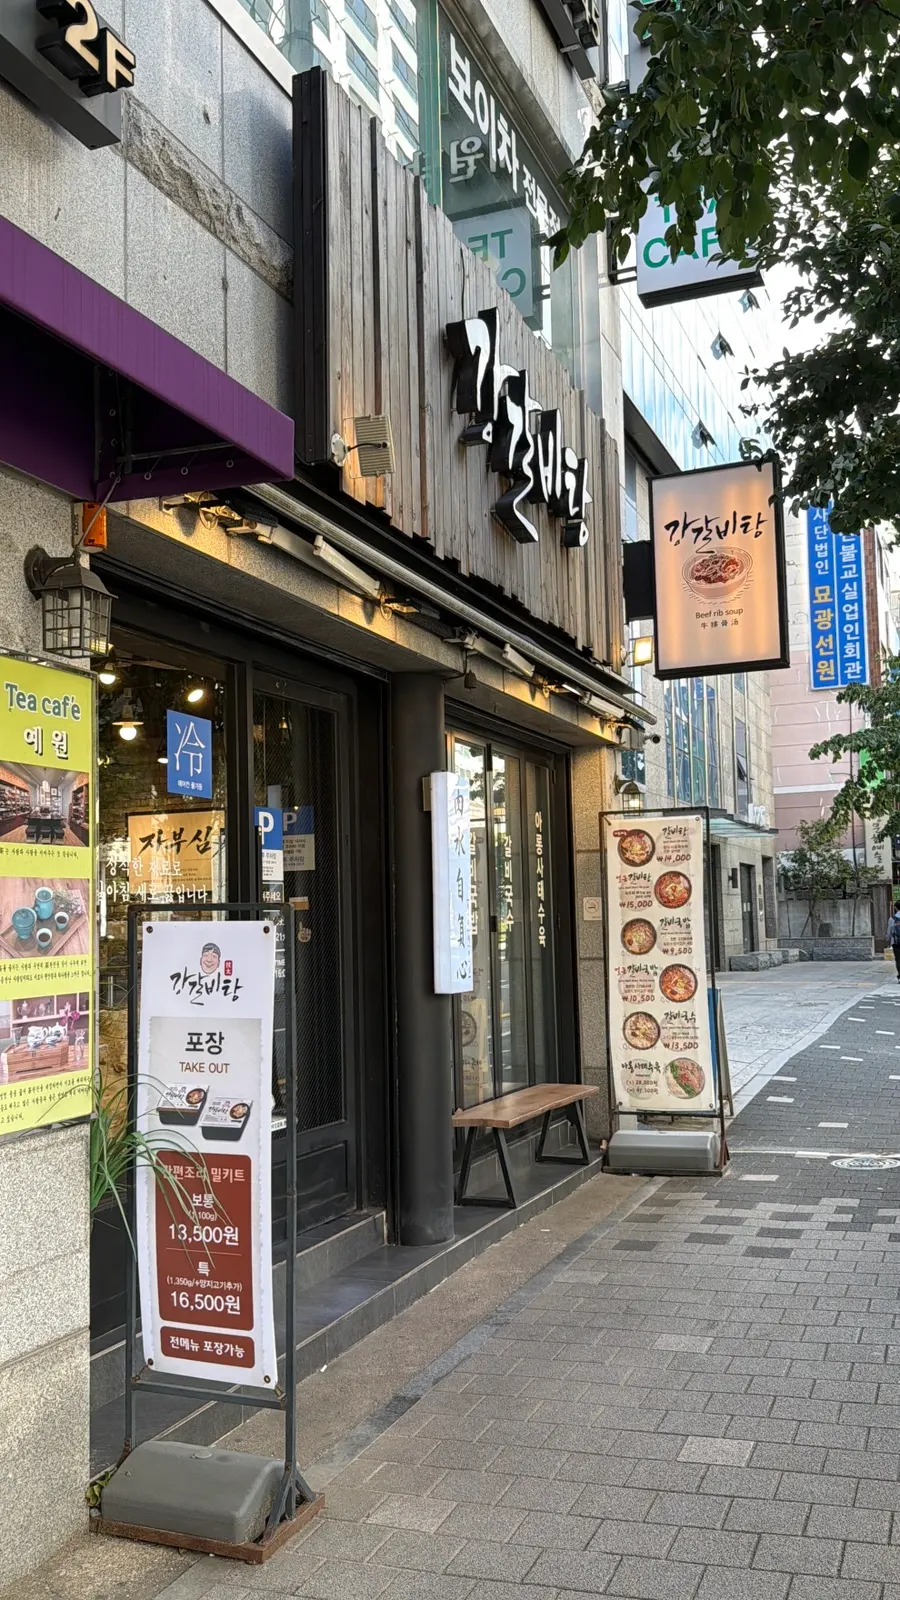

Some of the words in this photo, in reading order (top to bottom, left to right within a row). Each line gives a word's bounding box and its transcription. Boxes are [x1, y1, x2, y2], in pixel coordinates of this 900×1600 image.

[65, 0, 136, 90] 2F
[448, 33, 520, 194] 보이차
[464, 306, 593, 547] 강갈비탕
[664, 510, 768, 555] 강갈비탕
[813, 507, 830, 576] 사단법인
[695, 610, 712, 619] Beef
[713, 608, 724, 618] rib
[725, 607, 744, 618] soup
[838, 533, 863, 680] 불교실업인회관
[813, 584, 836, 682] 묘광선원
[4, 681, 38, 713] Tea
[174, 721, 206, 777] 冷
[258, 811, 275, 845] P
[283, 811, 298, 832] P
[138, 826, 214, 856] 자부심
[656, 853, 692, 863] ₩14,000
[503, 835, 515, 933] 갈비국수
[534, 811, 547, 948] 아롱사태수육
[619, 899, 653, 910] ₩15,000
[662, 946, 693, 957] ₩9,500
[170, 966, 244, 1006] 강갈비탕
[622, 994, 656, 1004] ₩10,500
[185, 1031, 225, 1056] 포장
[663, 1041, 699, 1051] ₩13,500
[179, 1061, 205, 1074] TAKE
[208, 1062, 230, 1074] OUT
[211, 1167, 246, 1184] 밀키트
[192, 1193, 214, 1209] 보통
[168, 1223, 240, 1247] 13,500원
[197, 1261, 210, 1277] 특
[170, 1290, 241, 1315] 16,500원
[169, 1335, 200, 1352] 전메뉴
[203, 1340, 246, 1359] 포장가능
